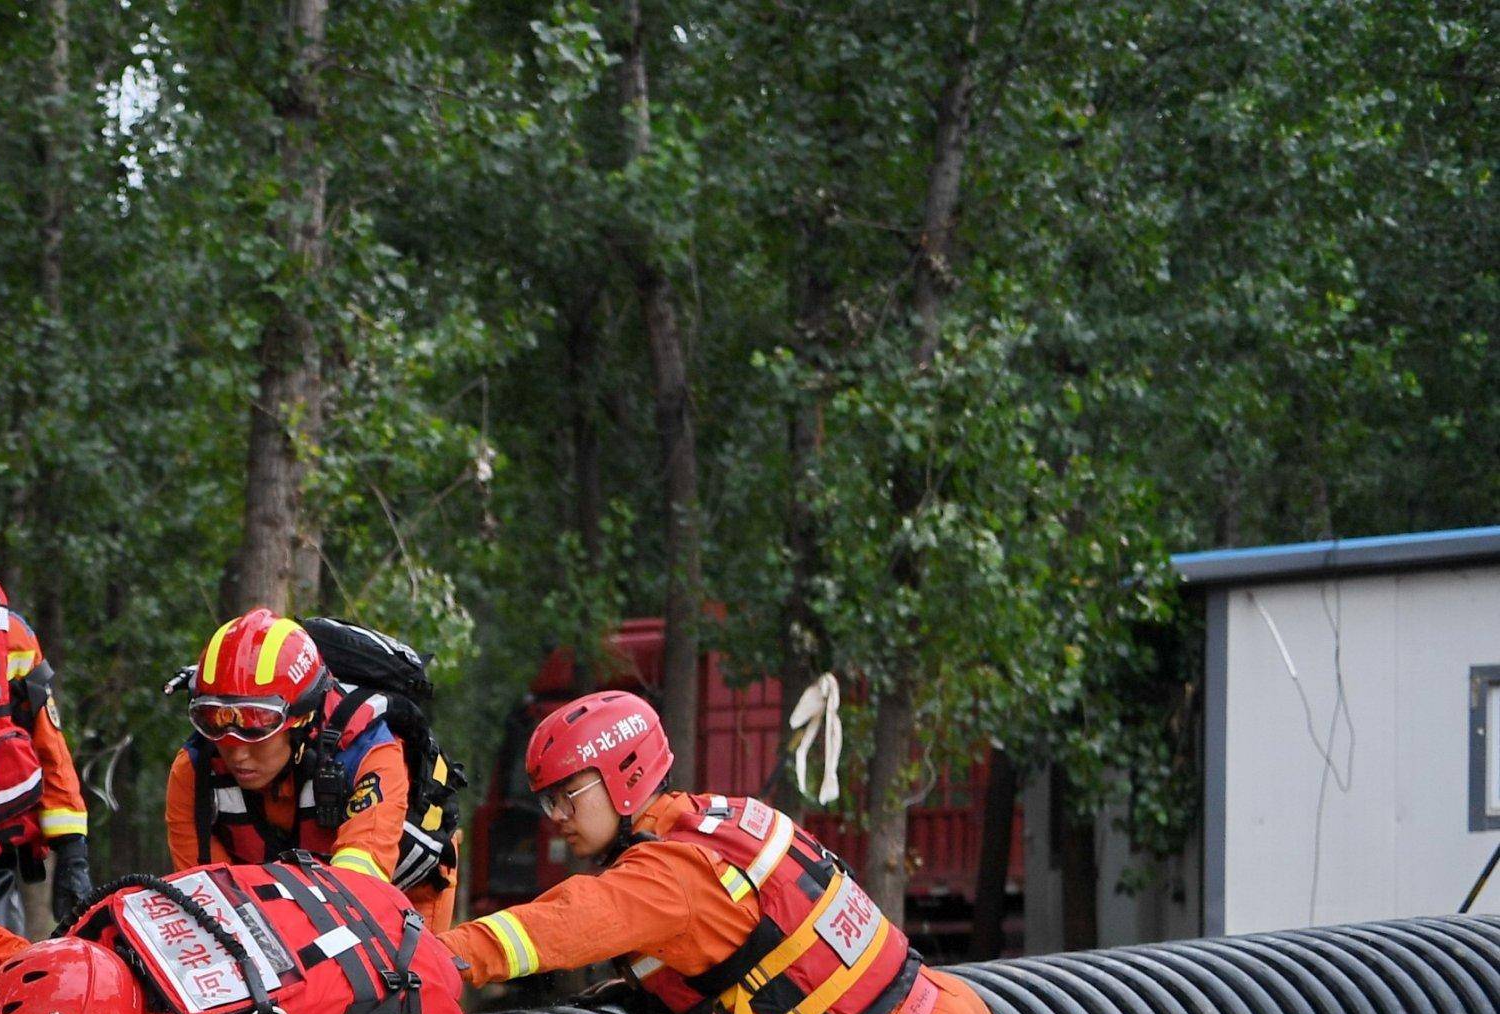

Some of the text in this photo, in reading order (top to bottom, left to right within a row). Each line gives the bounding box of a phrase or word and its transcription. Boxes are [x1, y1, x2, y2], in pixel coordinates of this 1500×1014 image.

[576, 713, 648, 762] 河北消防
[142, 893, 232, 998] 河北消防
